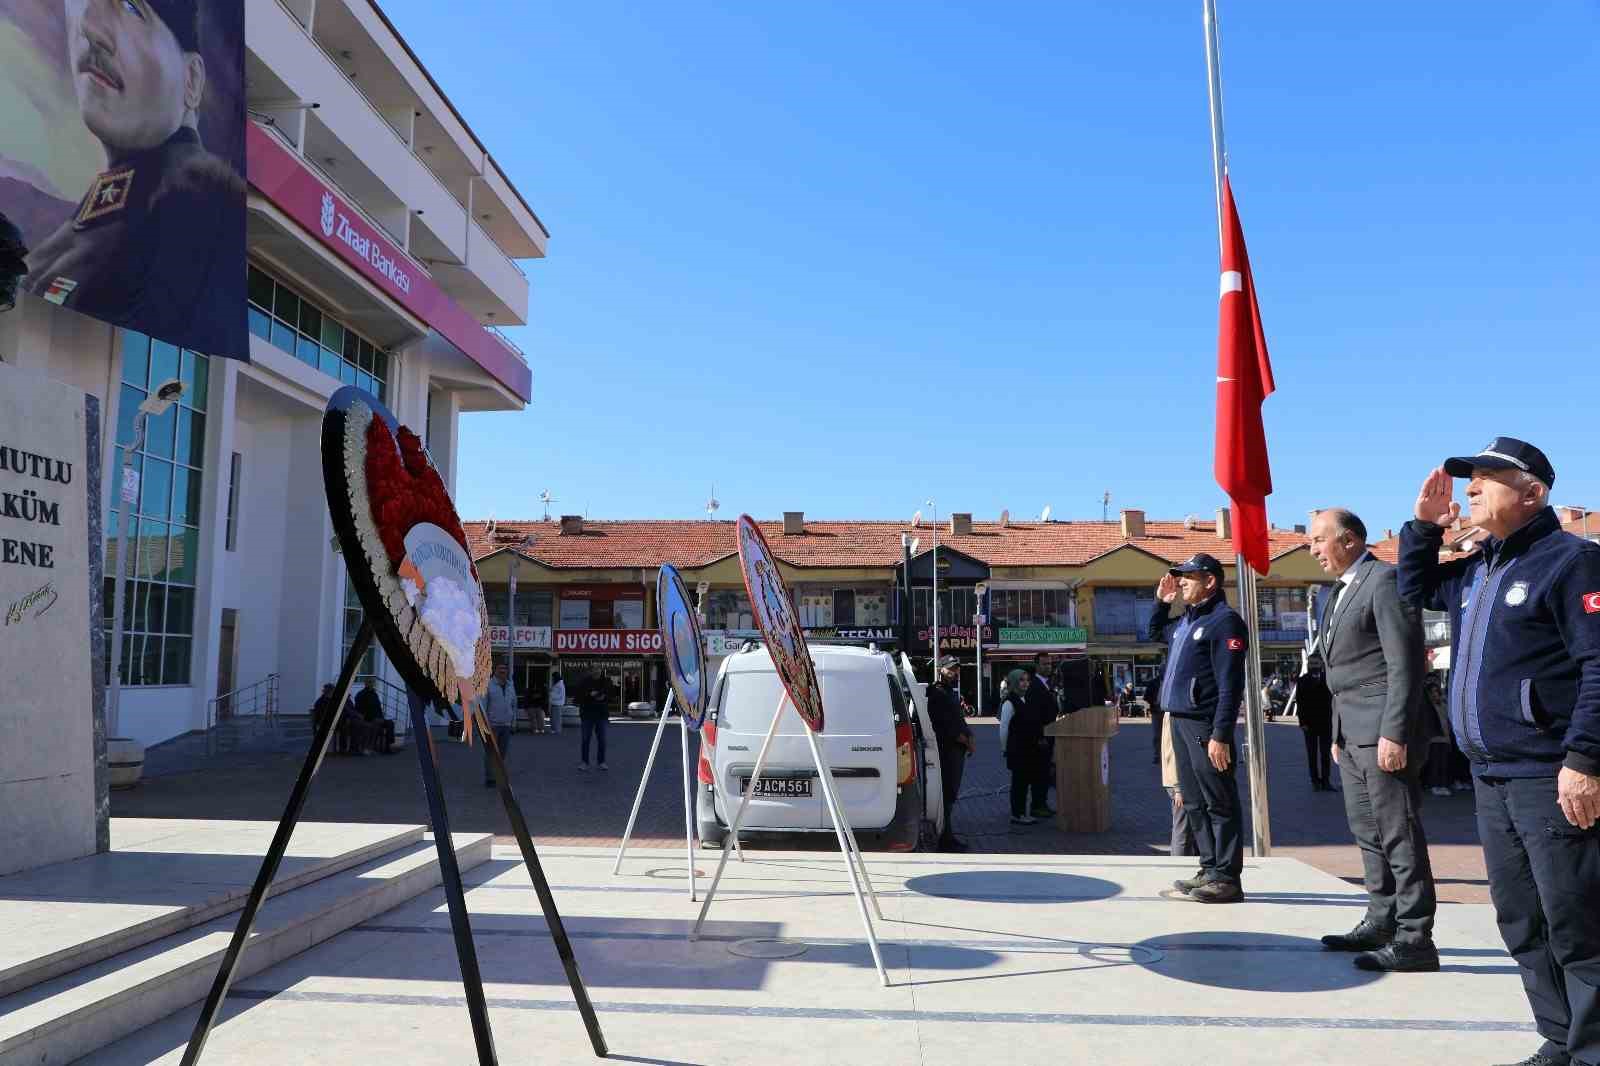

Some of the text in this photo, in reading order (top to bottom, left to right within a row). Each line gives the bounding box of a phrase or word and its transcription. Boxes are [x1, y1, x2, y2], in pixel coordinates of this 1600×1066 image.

[335, 213, 409, 294] Ziraat Bankası
[0, 489, 60, 526] KÜM
[1, 538, 54, 569] ENE
[557, 633, 620, 649] DUYGUN
[626, 633, 662, 650] SiGO
[764, 780, 786, 793] ACM
[788, 780, 809, 793] 561
